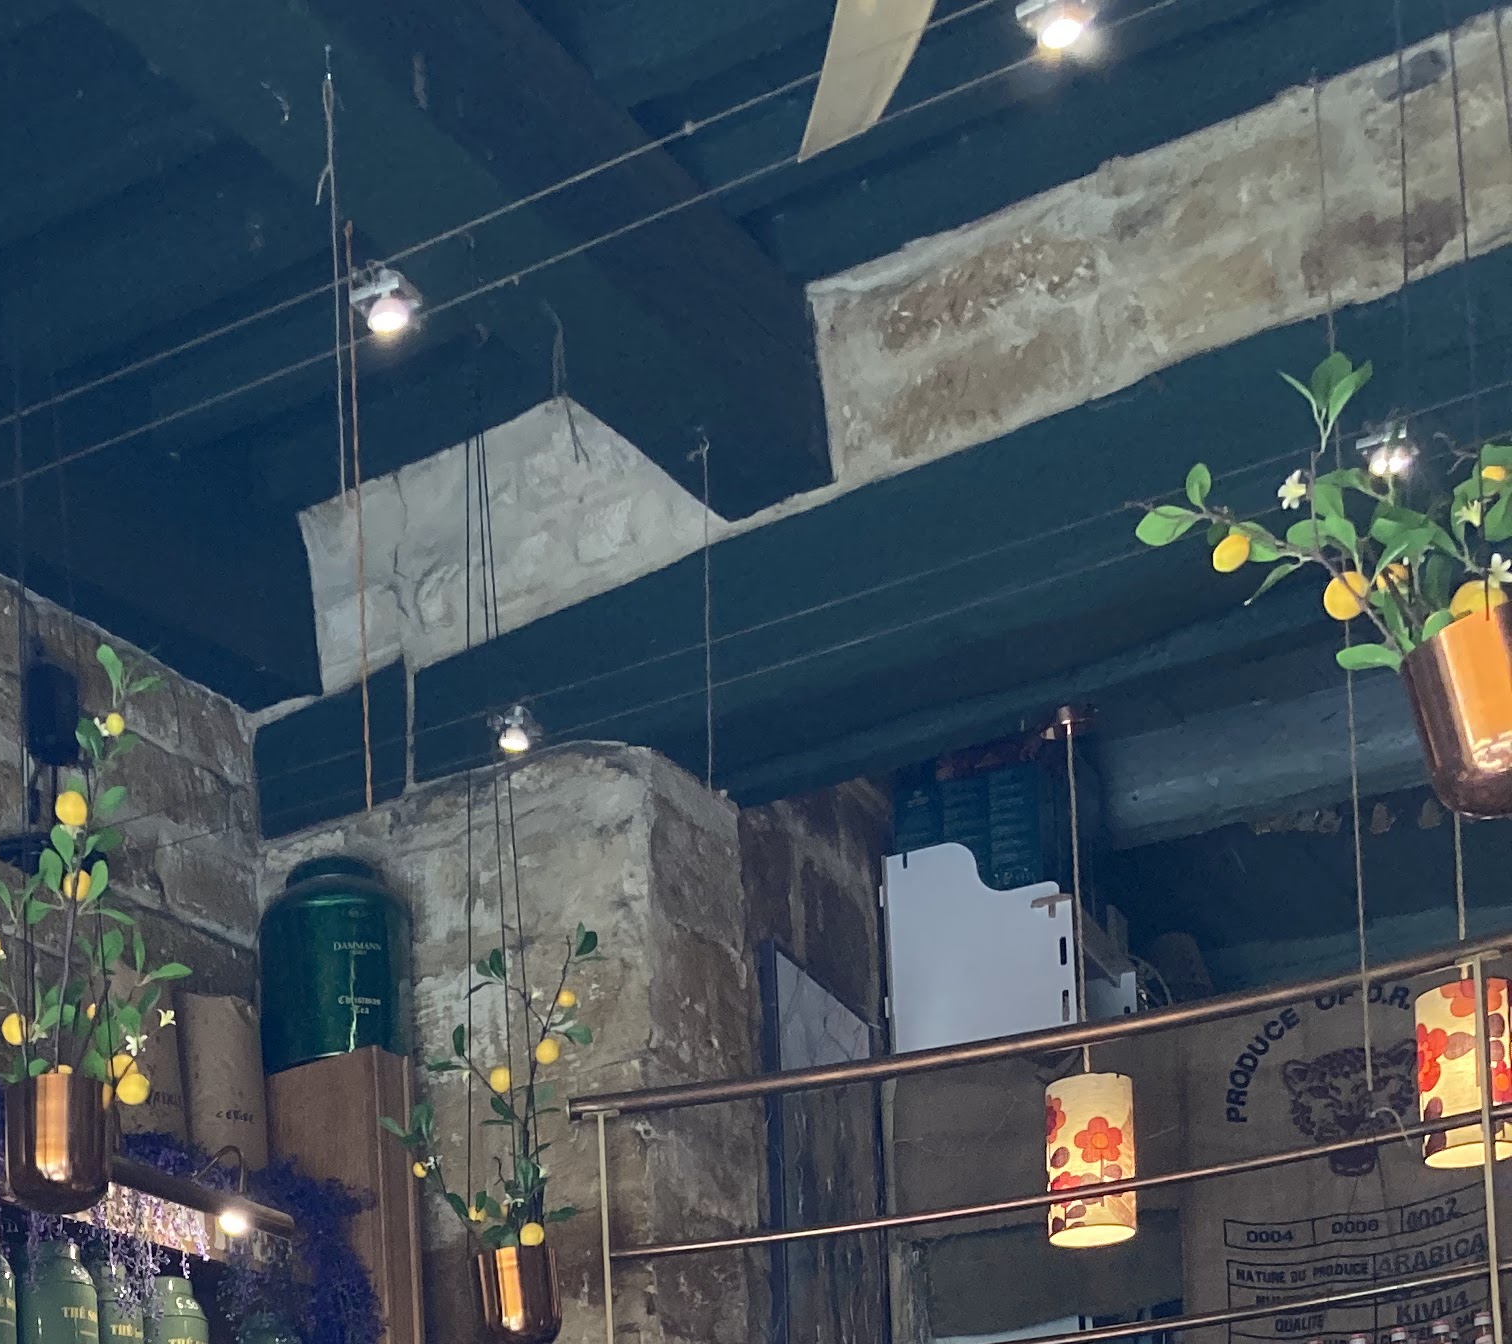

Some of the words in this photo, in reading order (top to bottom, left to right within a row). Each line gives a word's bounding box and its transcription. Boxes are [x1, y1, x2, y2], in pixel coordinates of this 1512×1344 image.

[1225, 1007, 1301, 1123] PRODUCE
[1236, 1265, 1287, 1284] NATURE
[1289, 1268, 1307, 1283] DU
[1311, 1262, 1369, 1280] PRODUCE
